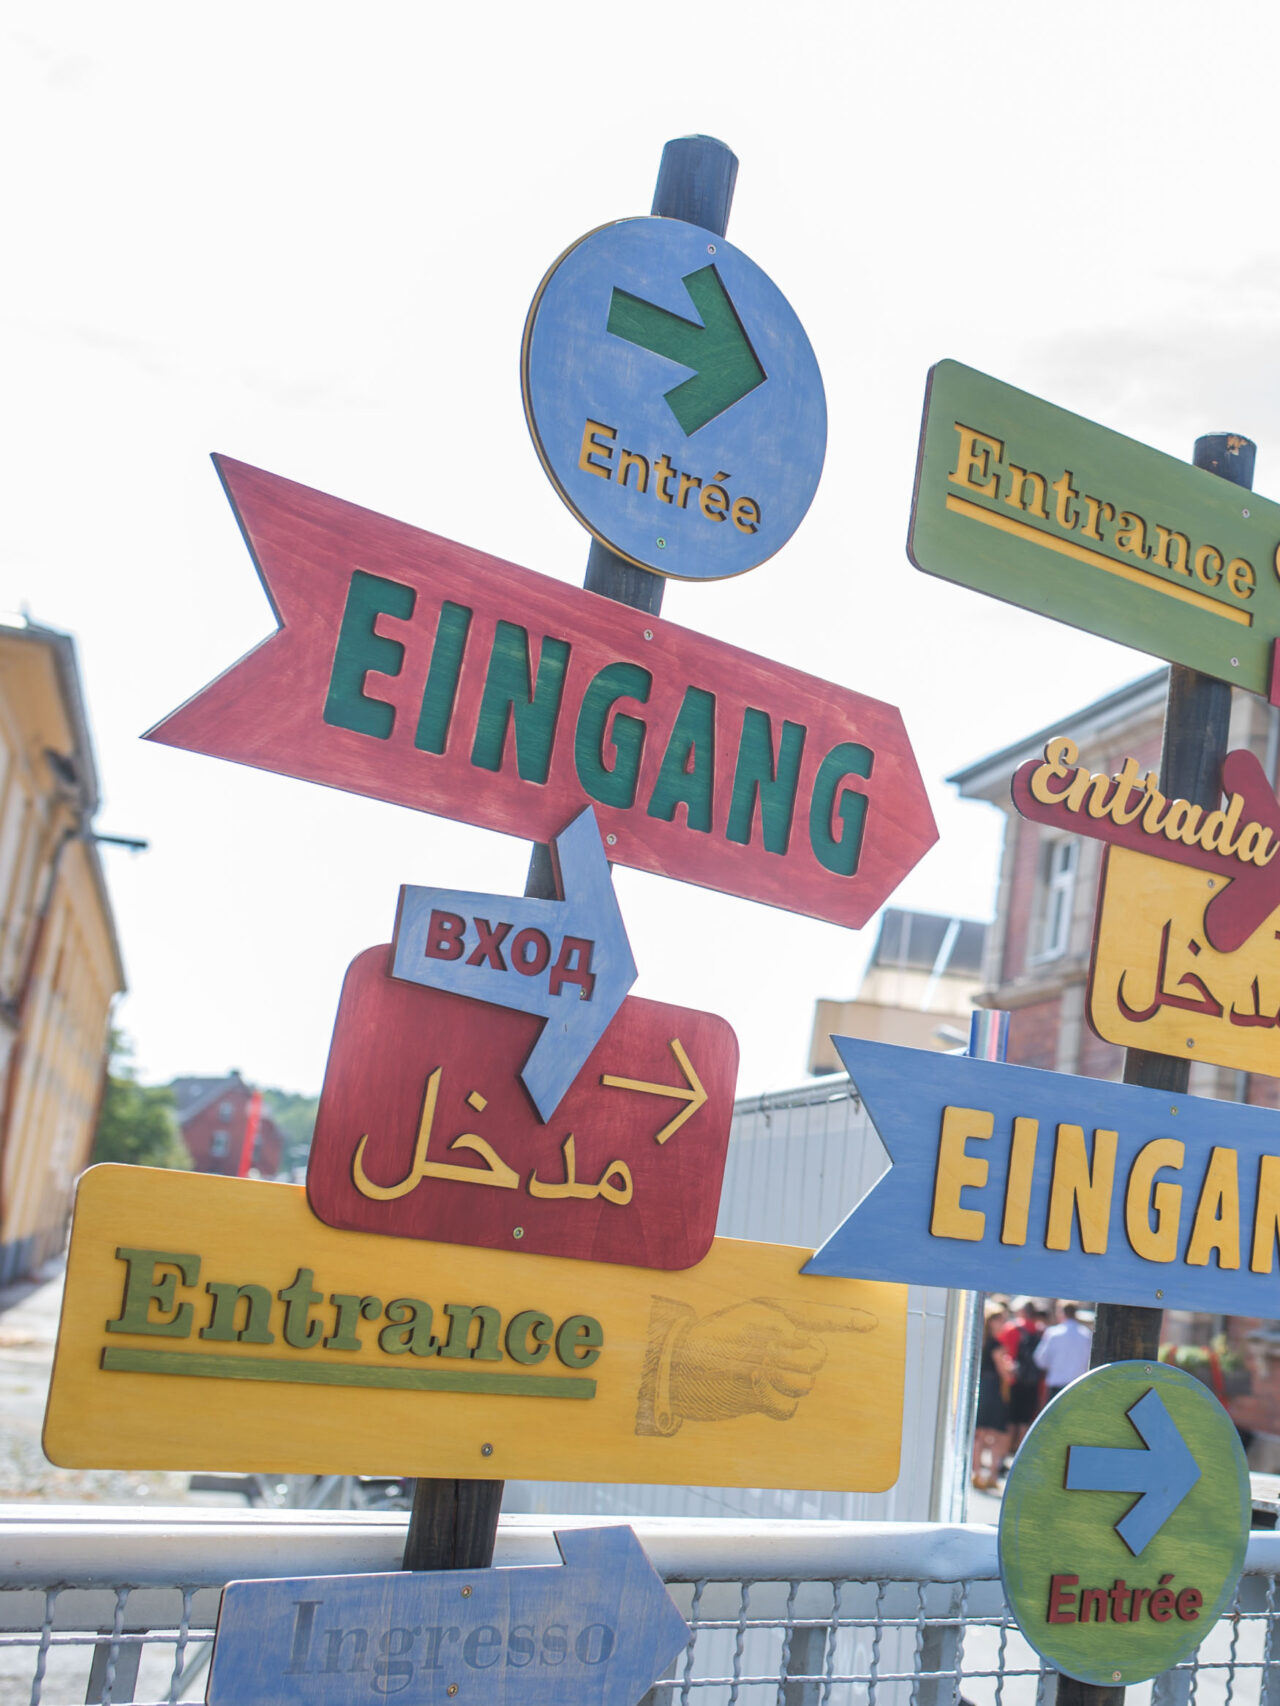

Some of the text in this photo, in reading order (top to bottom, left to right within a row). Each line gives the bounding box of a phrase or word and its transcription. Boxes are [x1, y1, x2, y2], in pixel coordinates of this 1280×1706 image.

[578, 417, 761, 534] Entrée
[947, 421, 1256, 600] Entrance
[323, 570, 875, 877] EINGANG
[1031, 736, 1280, 866] Entrada
[424, 909, 597, 1001] ВХОД
[352, 1066, 633, 1206] مدخل
[106, 1247, 604, 1369] Entrance
[283, 1600, 615, 1694] Ingresso
[1047, 1574, 1203, 1623] Entrée
